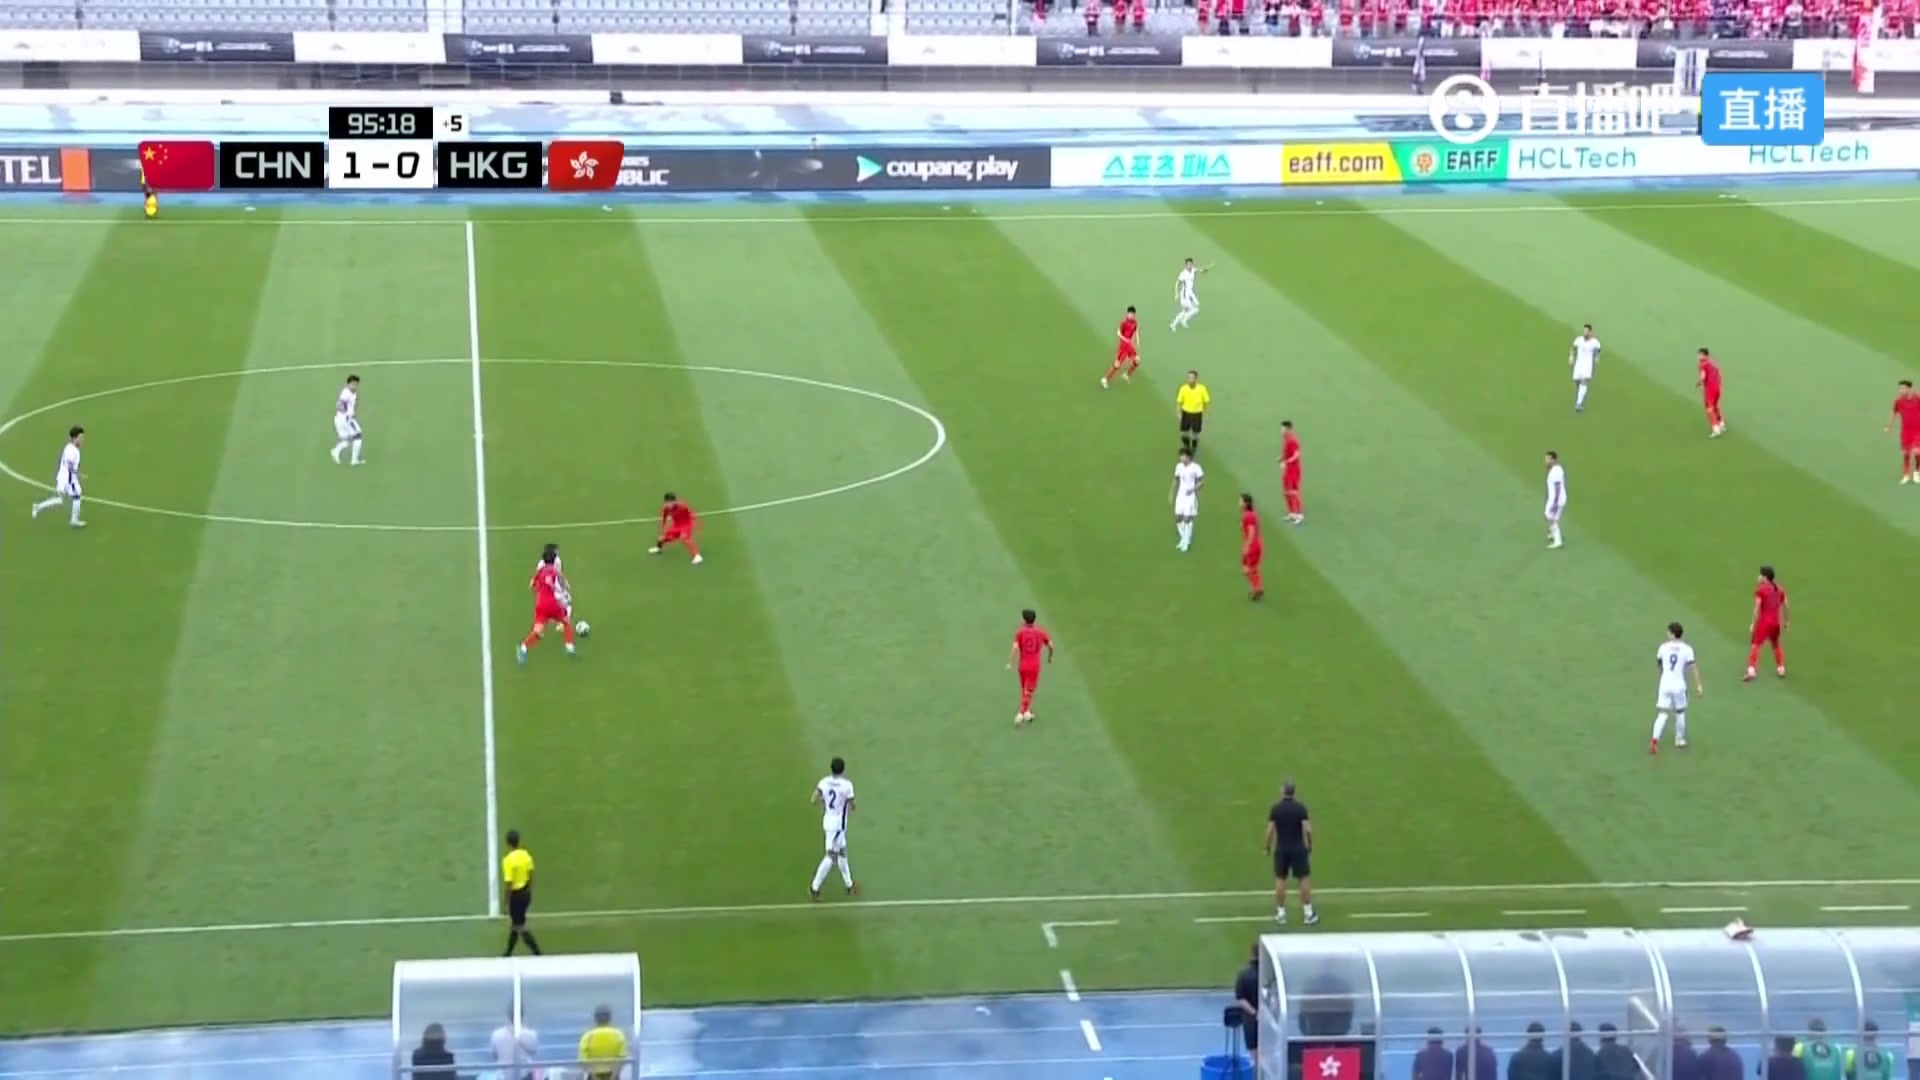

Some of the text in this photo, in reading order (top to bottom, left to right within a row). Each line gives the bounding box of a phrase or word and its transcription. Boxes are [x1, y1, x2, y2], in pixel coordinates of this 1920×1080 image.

[886, 154, 1019, 182] coupang play
[1102, 155, 1175, 178] 스포츠
[1288, 151, 1384, 173] eaff.com
[1446, 150, 1498, 171] EAFF
[1518, 147, 1637, 170] HCLTech
[1669, 653, 1678, 672] 9
[828, 789, 837, 809] 2
